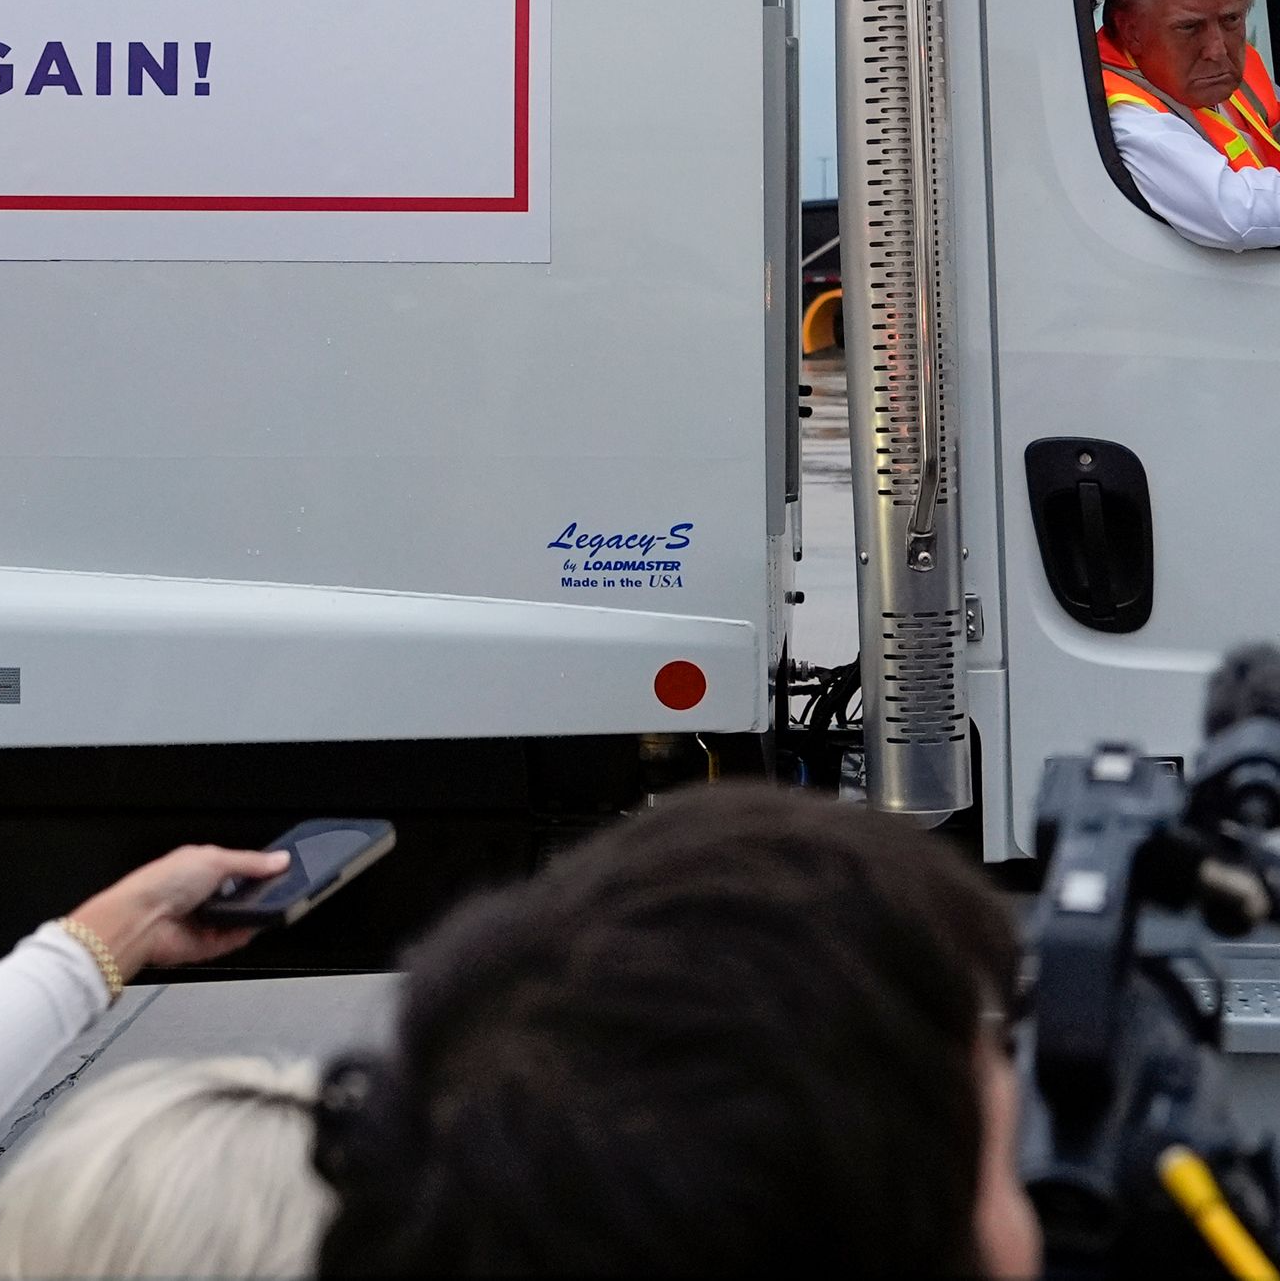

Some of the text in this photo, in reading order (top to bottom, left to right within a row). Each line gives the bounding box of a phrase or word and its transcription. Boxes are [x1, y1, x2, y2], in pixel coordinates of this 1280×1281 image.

[546, 522, 695, 558] Legacy-S
[563, 559, 682, 573] by LOADMASTER
[561, 574, 684, 589] Made in the USA
